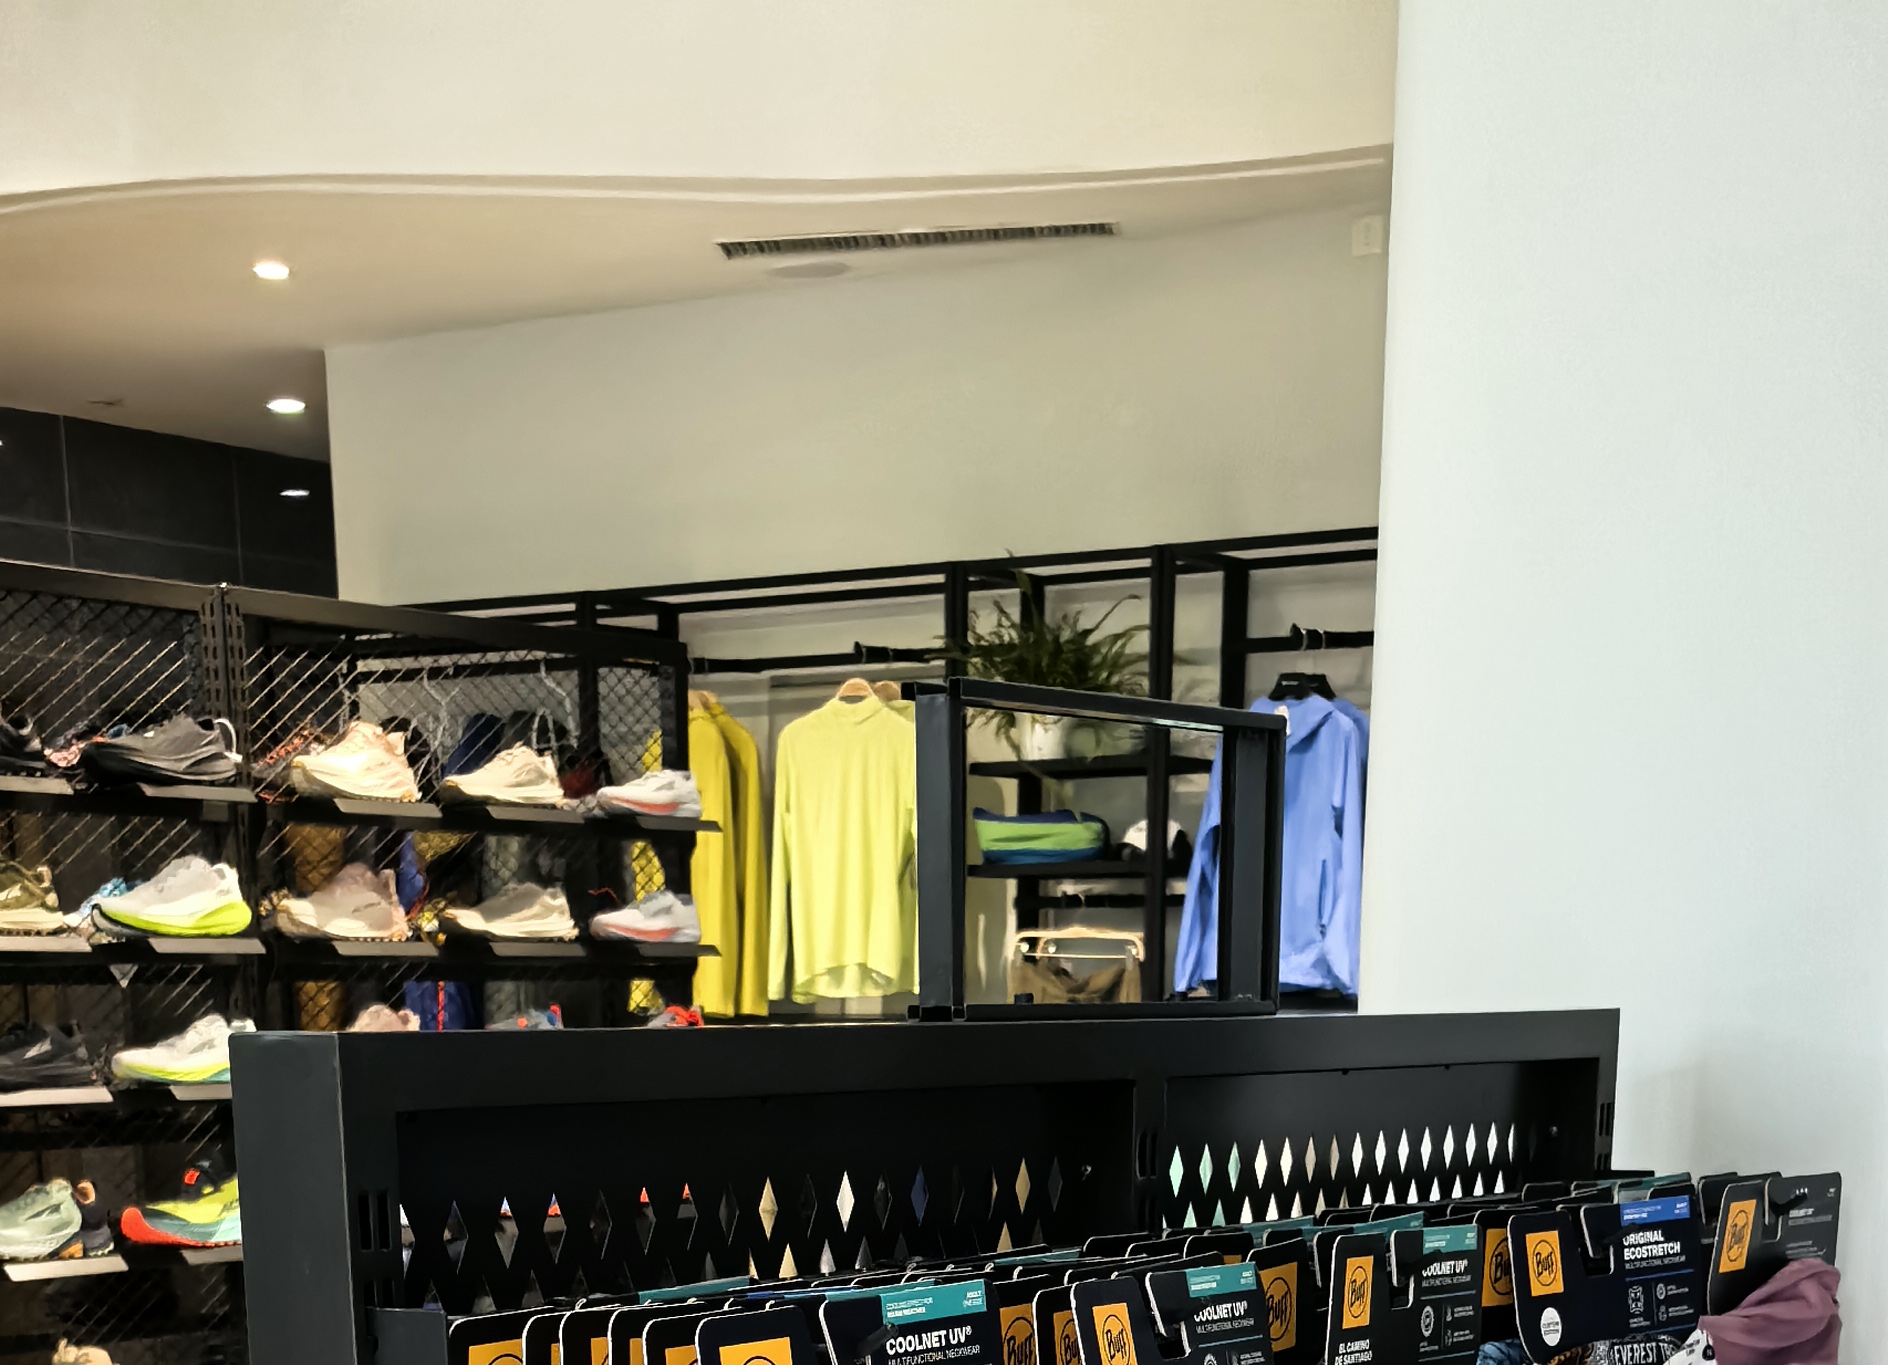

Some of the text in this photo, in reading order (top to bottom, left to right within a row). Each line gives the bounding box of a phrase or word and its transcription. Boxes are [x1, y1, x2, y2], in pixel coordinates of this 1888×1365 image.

[1623, 1230, 1664, 1246] ORIGINAL
[1624, 1242, 1680, 1261] ECOSTRETCH
[1494, 1251, 1511, 1289] Bu
[1535, 1252, 1554, 1278] Buff
[886, 1329, 947, 1356] COOLNET
[1105, 1328, 1127, 1361] Buff
[1614, 1342, 1657, 1365] EVEREST
